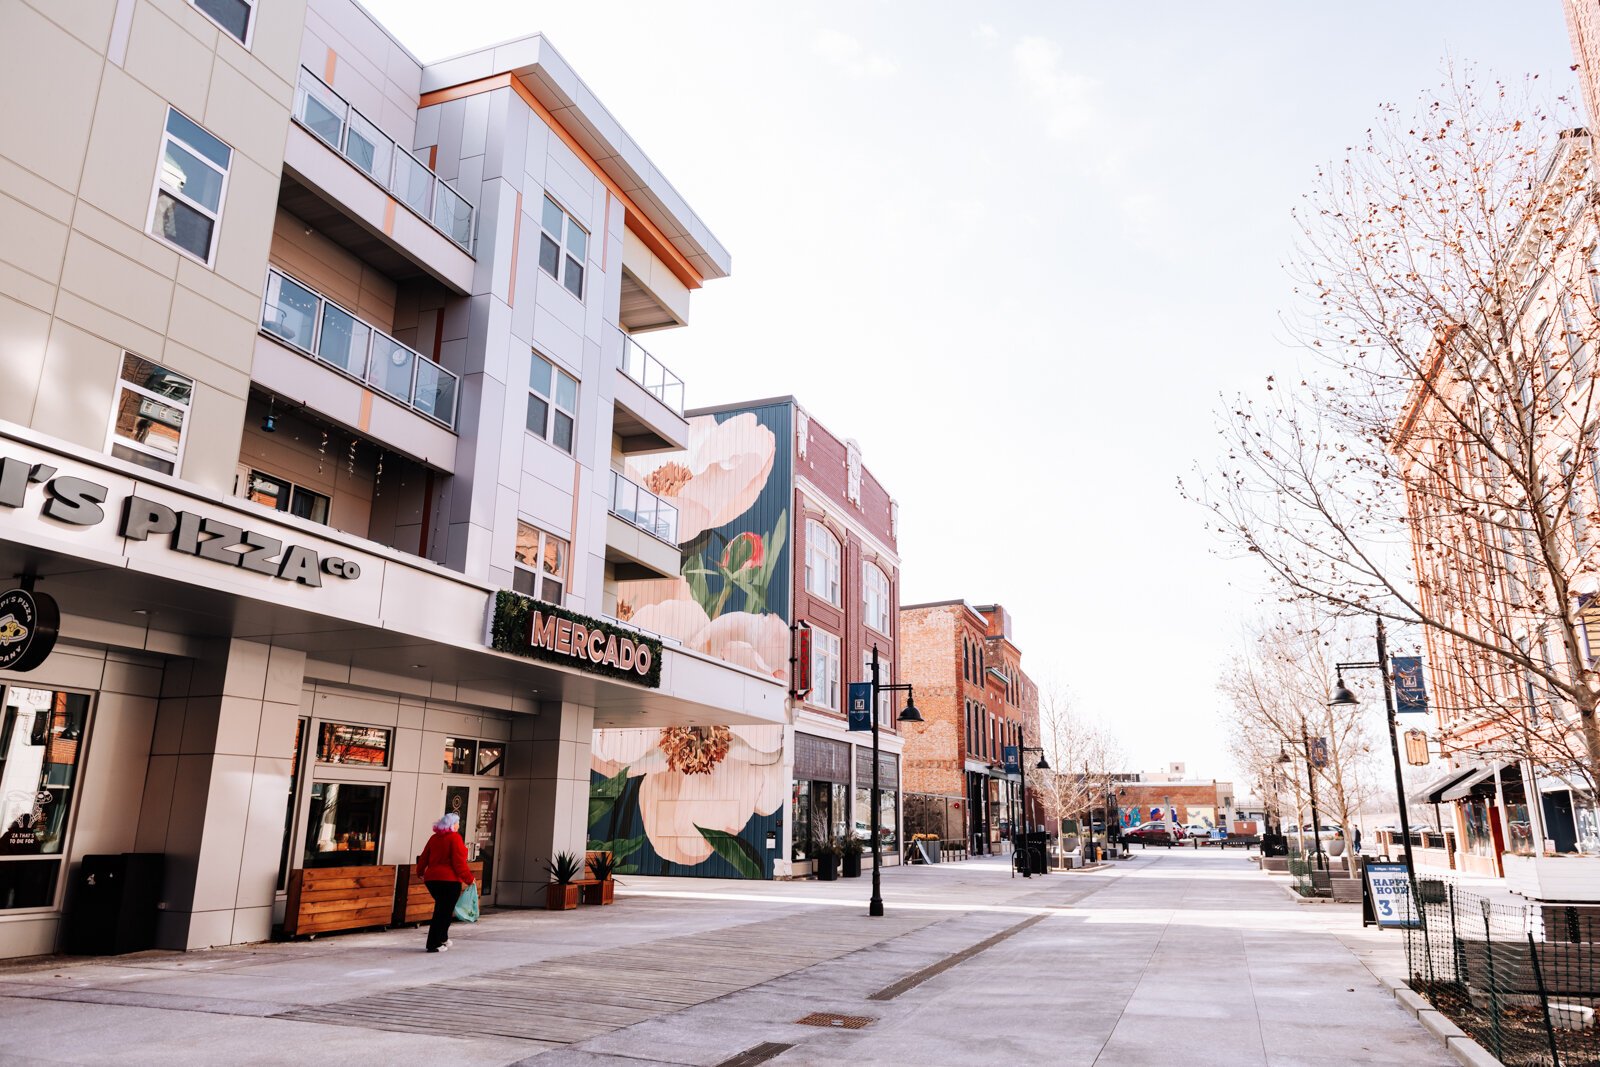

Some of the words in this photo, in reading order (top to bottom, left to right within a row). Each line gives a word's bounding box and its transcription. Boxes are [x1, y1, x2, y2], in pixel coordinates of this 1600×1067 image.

[120, 495, 322, 588] PIZZA
[18, 597, 32, 622] PIZZA
[531, 610, 652, 676] MERCADO
[1373, 878, 1408, 886] HAPPY
[1378, 899, 1393, 916] 3
